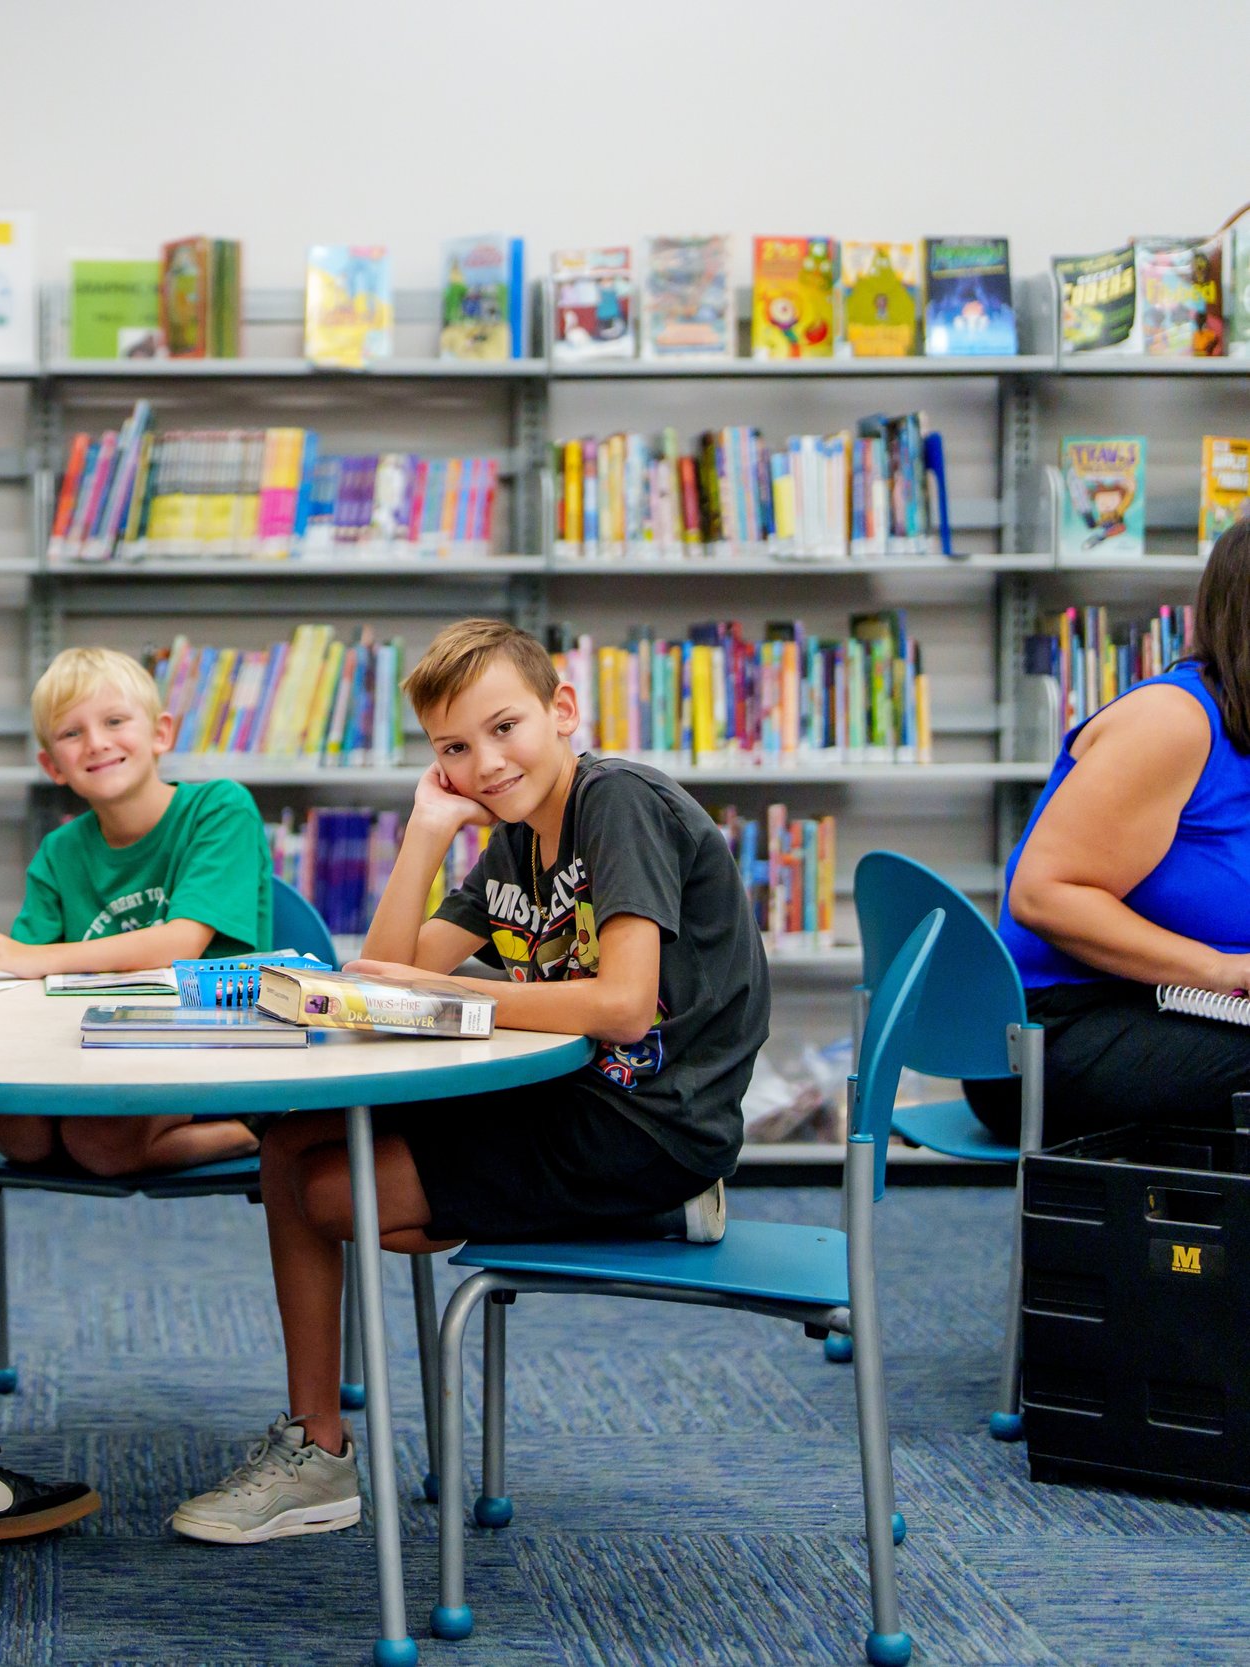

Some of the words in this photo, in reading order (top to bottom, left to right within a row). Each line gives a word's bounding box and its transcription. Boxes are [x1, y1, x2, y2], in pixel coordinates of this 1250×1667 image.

[365, 995, 394, 1009] WINGS
[400, 998, 421, 1011] FIRE
[347, 1009, 435, 1029] DRAGONSLAYER
[1171, 1244, 1202, 1269] M
